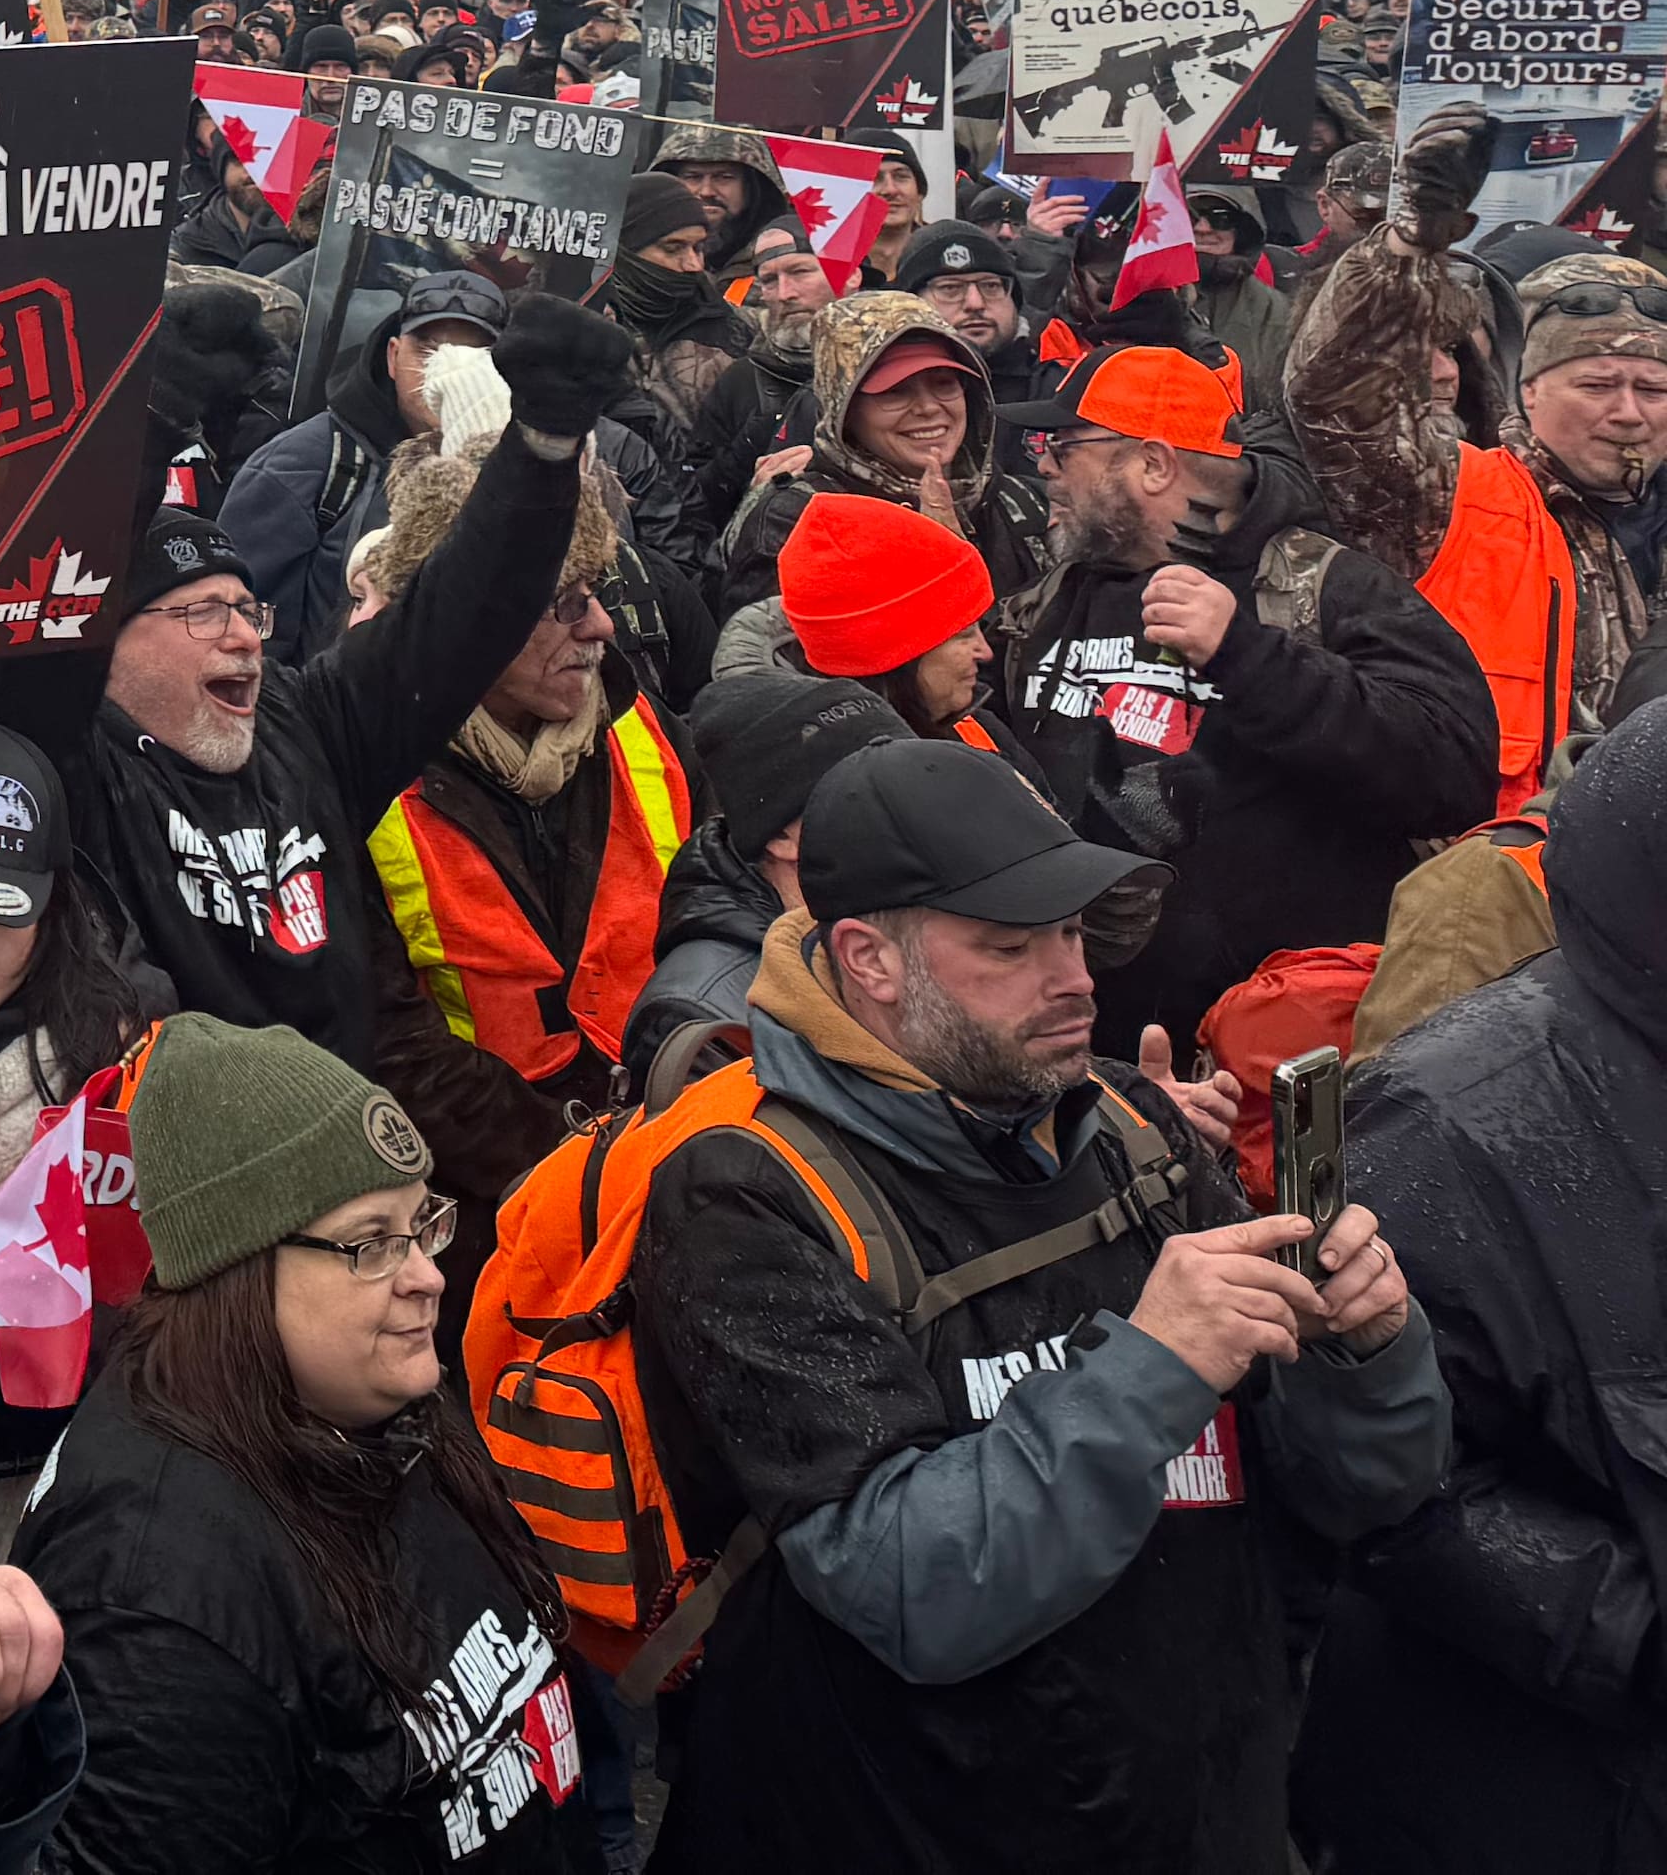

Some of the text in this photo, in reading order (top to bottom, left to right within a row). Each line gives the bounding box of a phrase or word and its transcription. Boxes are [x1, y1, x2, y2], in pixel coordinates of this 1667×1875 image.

[646, 26, 688, 62] PAS
[1428, 22, 1619, 53] d'abord.
[1425, 53, 1644, 90] Toujours.
[351, 85, 625, 157] PAS DE FOND
[1219, 153, 1250, 165] THE
[20, 159, 169, 236] VENDRE
[333, 178, 609, 260] PAS DE CONFIANCE.
[1119, 685, 1175, 723] PAS A
[1111, 708, 1170, 748] VENDRE
[448, 1608, 521, 1725] ARMES
